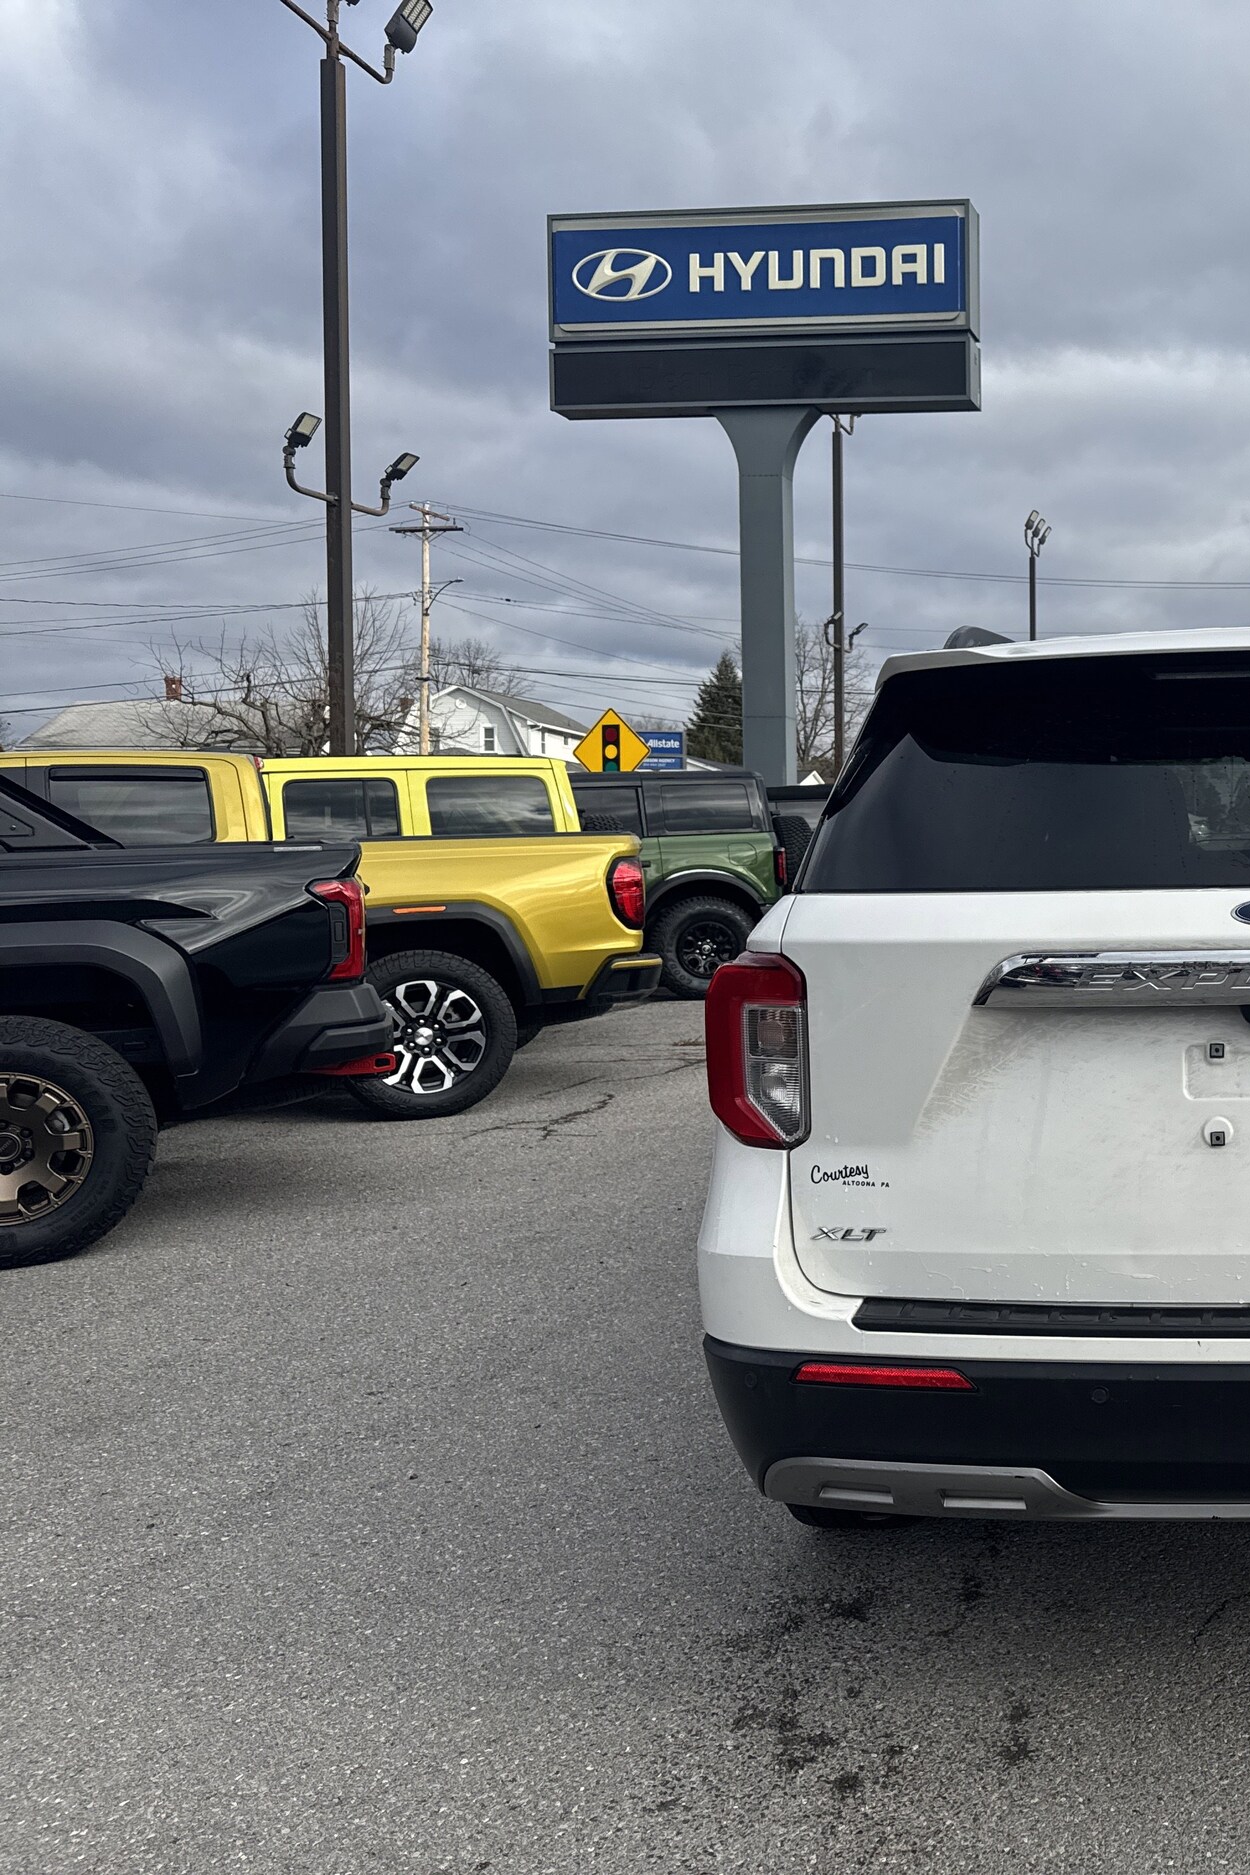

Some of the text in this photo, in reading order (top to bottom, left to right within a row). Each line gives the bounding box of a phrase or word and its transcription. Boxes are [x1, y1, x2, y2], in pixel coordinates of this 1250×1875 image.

[689, 243, 946, 293] HYUNDAI
[648, 738, 680, 748] Allstate
[810, 1164, 869, 1184] Courtesy
[810, 1226, 887, 1241] XLT
